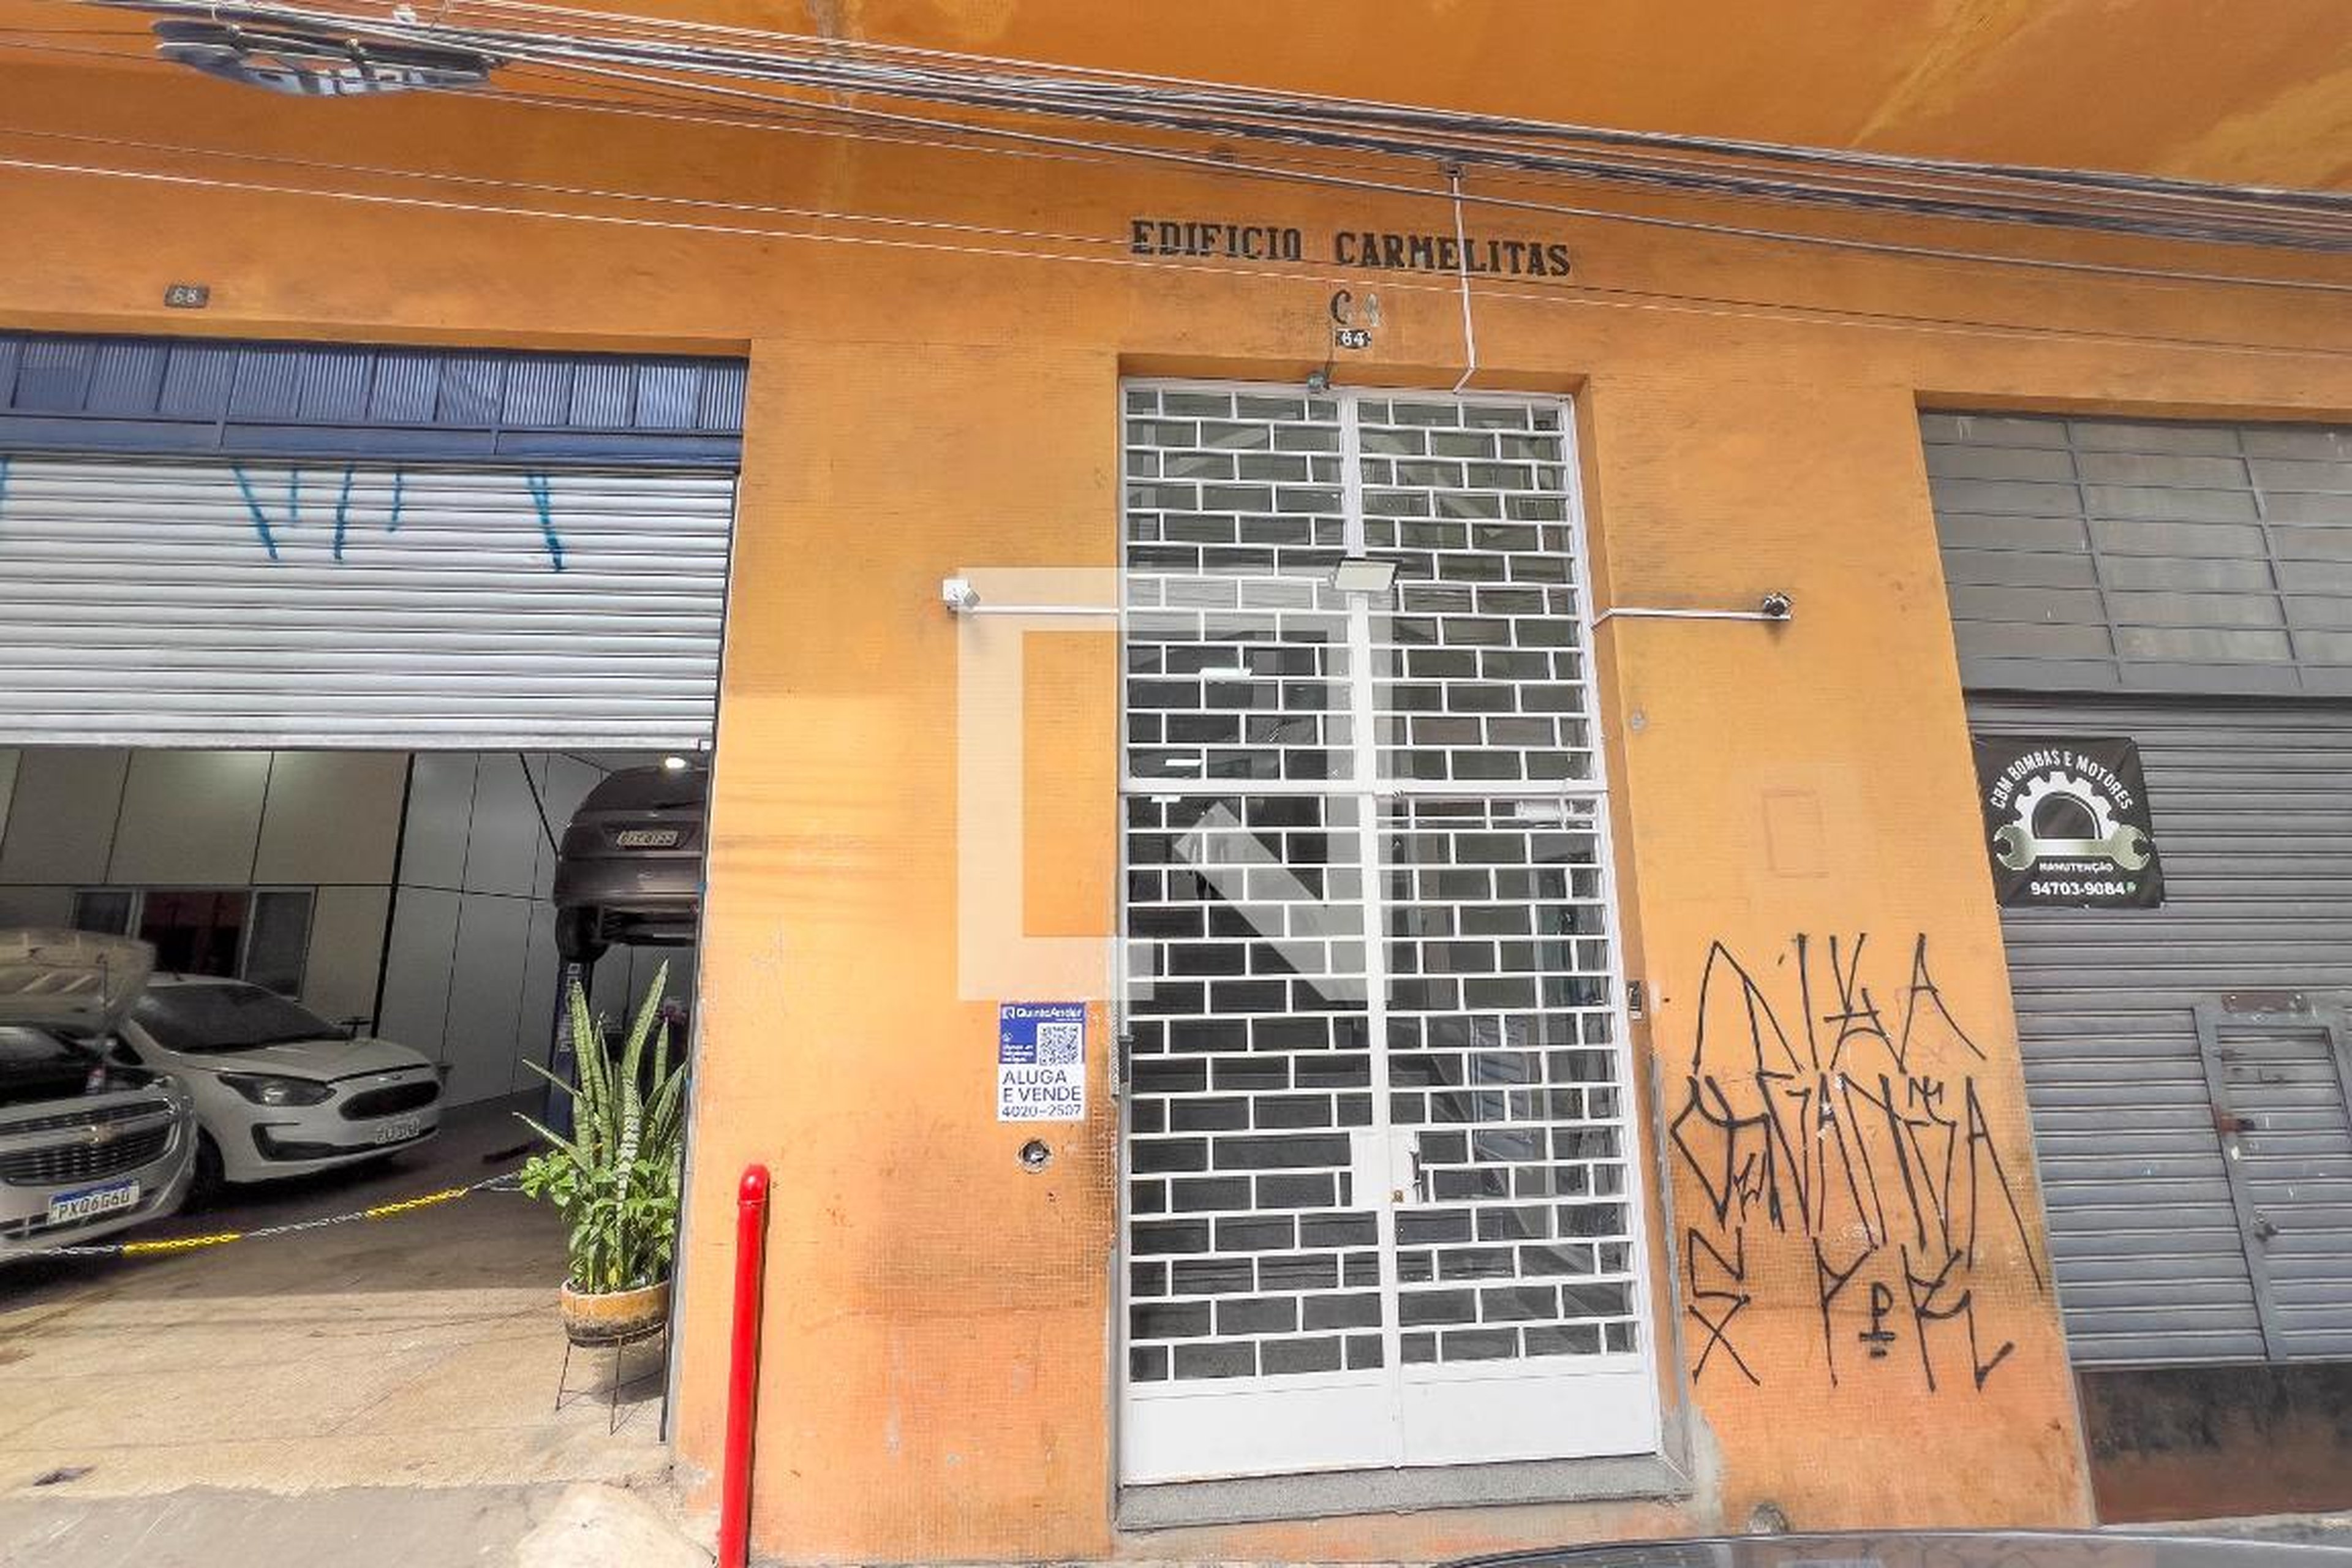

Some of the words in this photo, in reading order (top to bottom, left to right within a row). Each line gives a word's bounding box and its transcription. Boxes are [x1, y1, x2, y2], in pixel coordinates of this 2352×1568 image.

[1131, 220, 1302, 261] EDIFICIO
[1335, 232, 1570, 276] CARMELITAS
[1341, 331, 1365, 346] 64
[1991, 776, 2014, 809] CBM
[2007, 748, 2060, 781] BOMBAS
[2064, 751, 2073, 766] E
[2076, 755, 2133, 810] MOTORES
[2030, 881, 2125, 895] 94703-9084
[1002, 1069, 1066, 1084] ALUGA
[1004, 1087, 1013, 1102] E
[1018, 1085, 1081, 1101] VENDE
